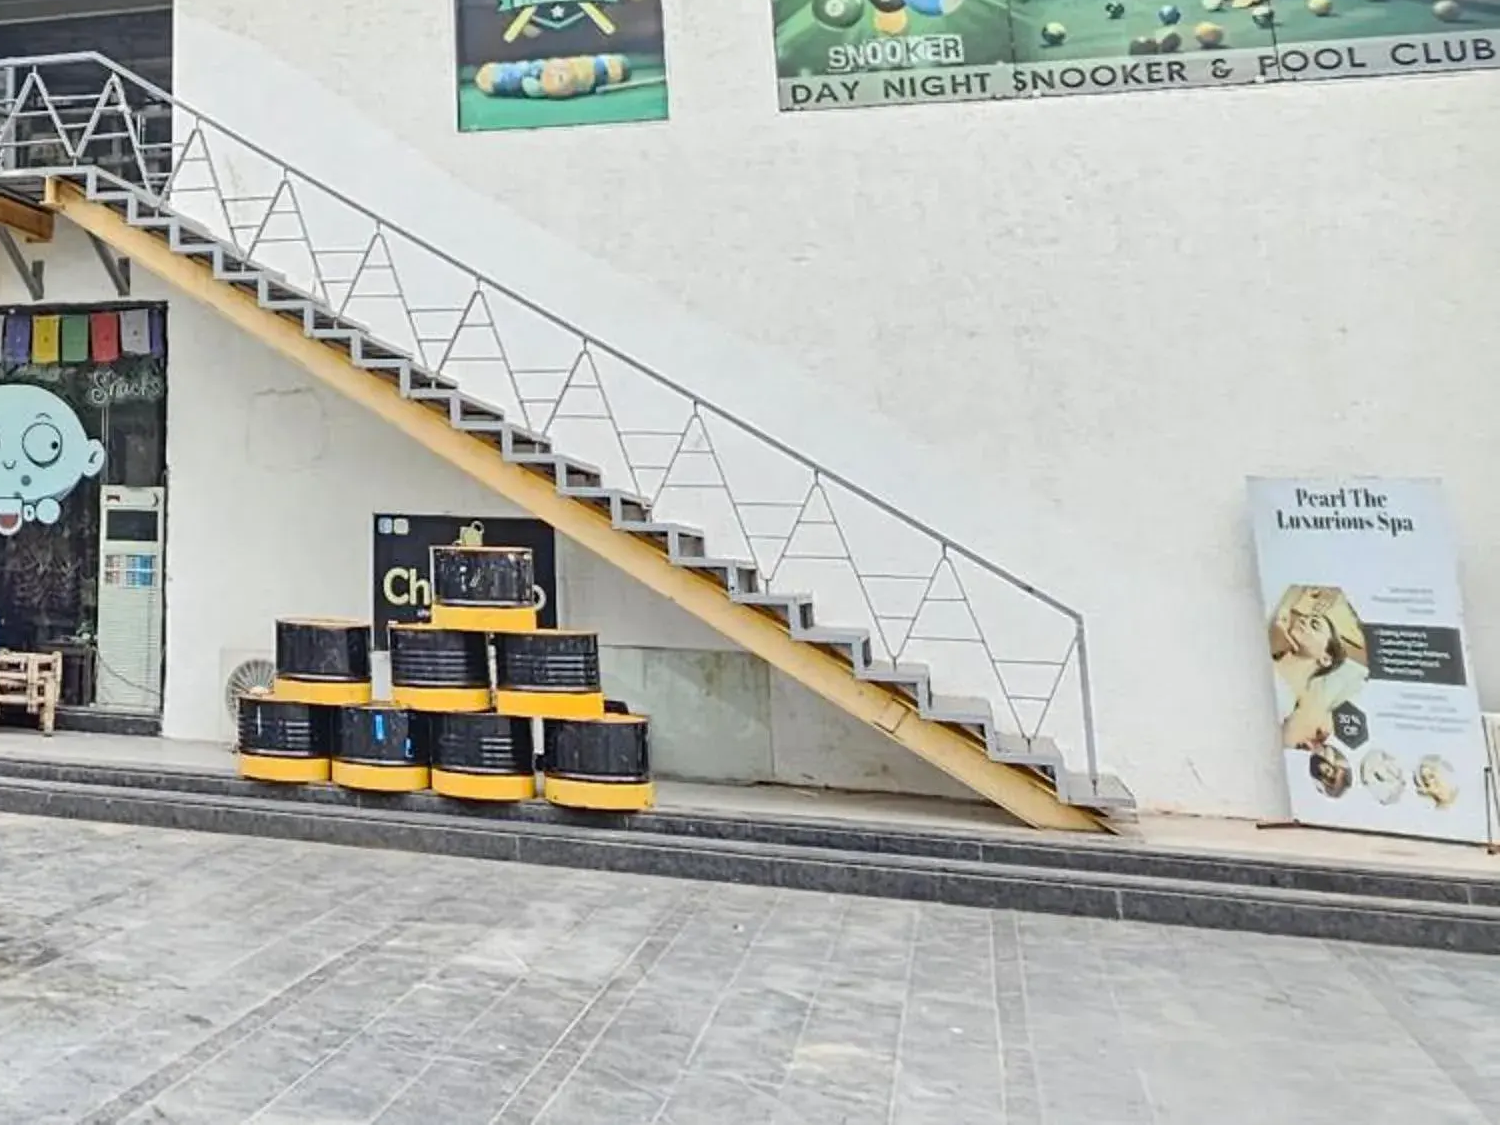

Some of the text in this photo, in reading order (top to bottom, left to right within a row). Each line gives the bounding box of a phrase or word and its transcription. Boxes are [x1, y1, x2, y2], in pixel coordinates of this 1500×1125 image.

[828, 35, 965, 73] SNOOKER
[790, 38, 1496, 105] DAY NIGHT SNOOKER & POOL CLUB
[1295, 487, 1388, 509] Pearl The
[1276, 508, 1414, 537] Luxurious Spa
